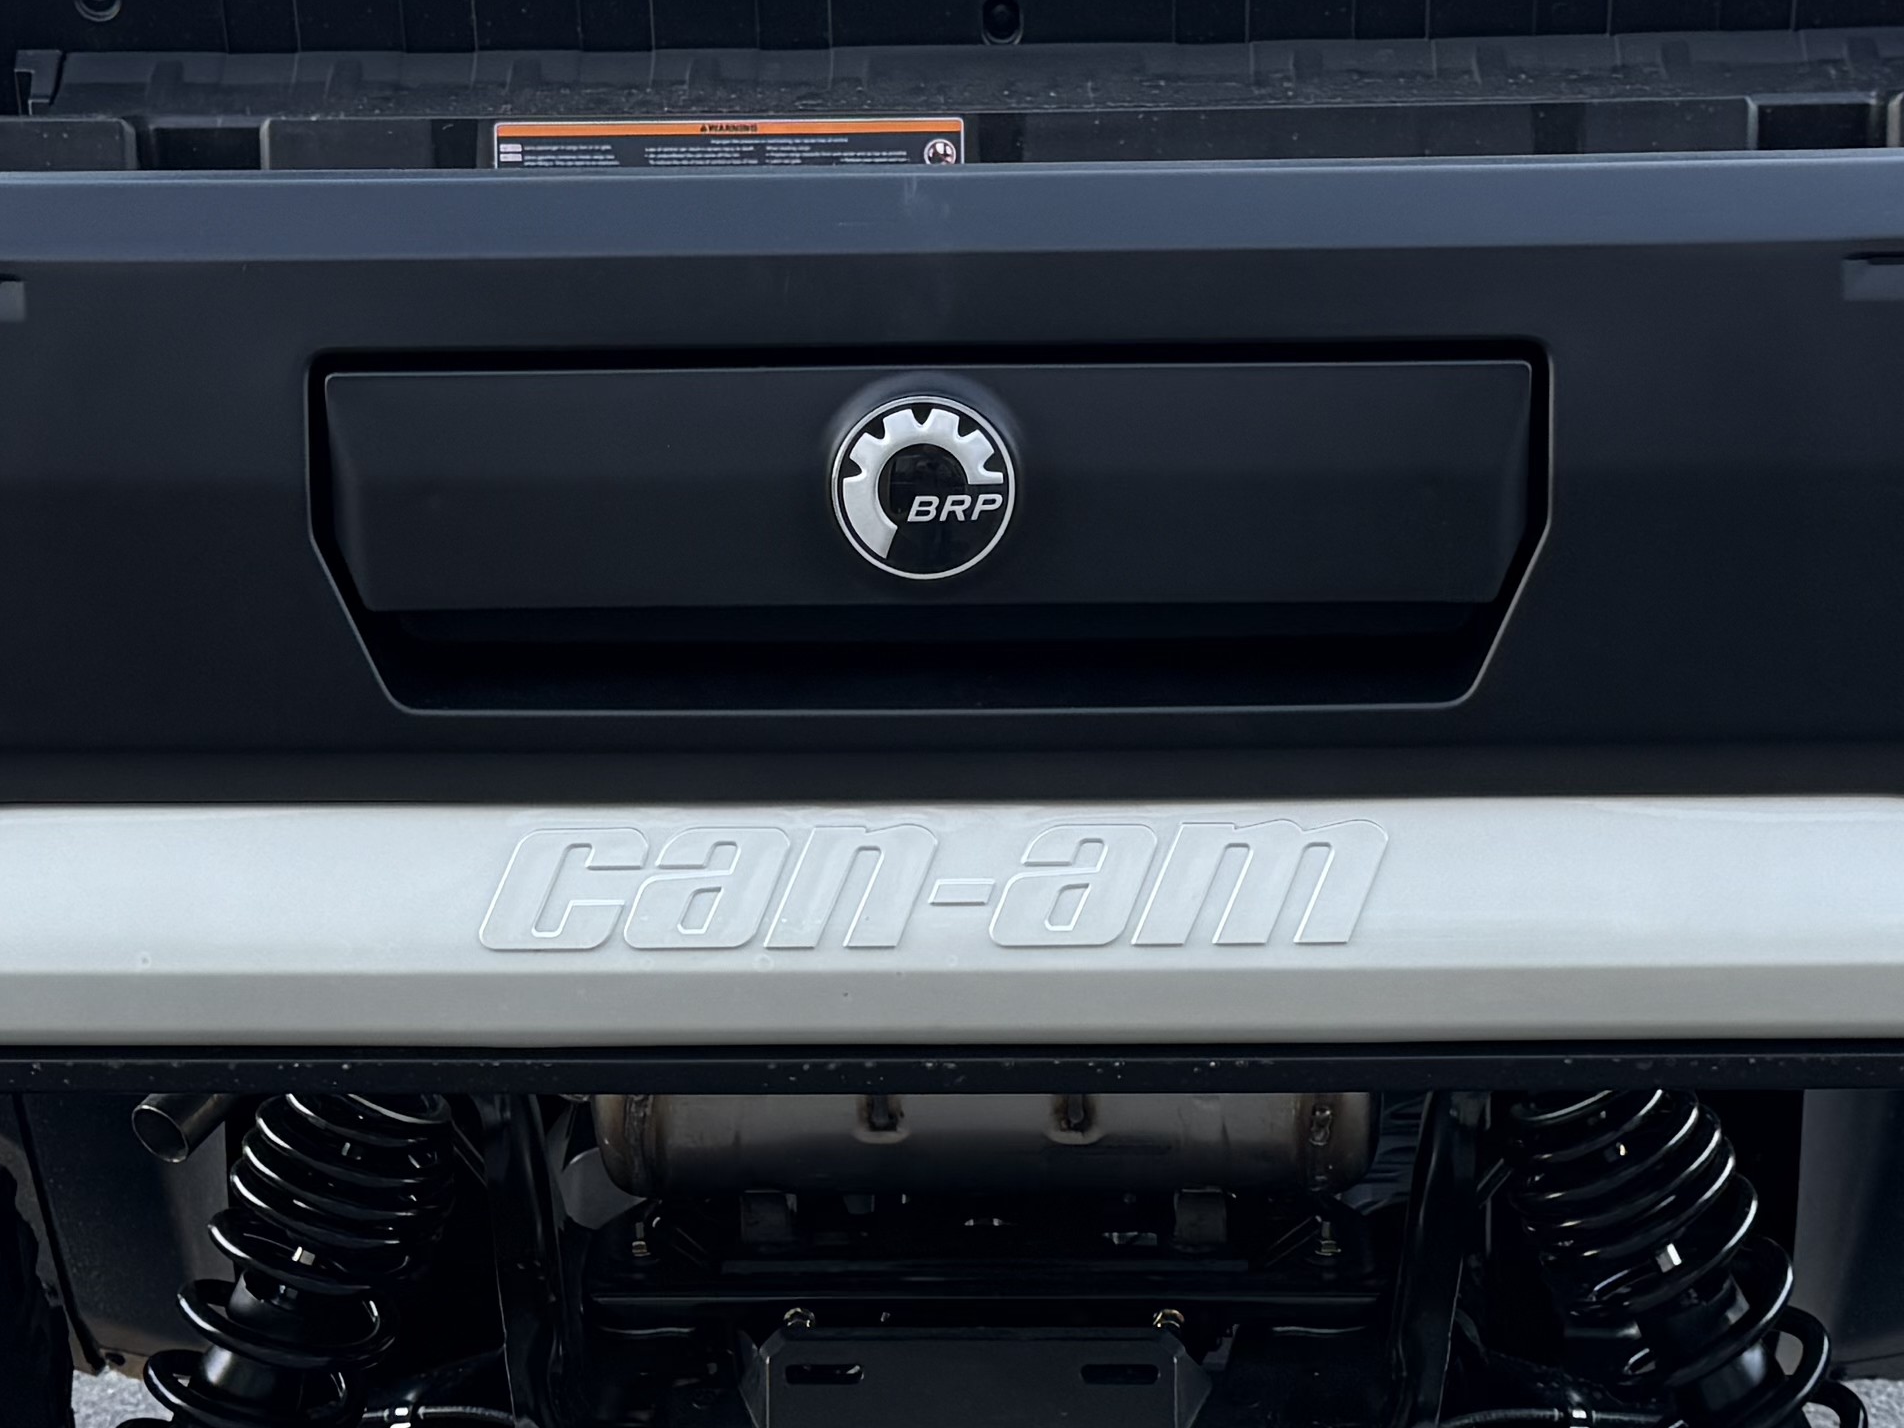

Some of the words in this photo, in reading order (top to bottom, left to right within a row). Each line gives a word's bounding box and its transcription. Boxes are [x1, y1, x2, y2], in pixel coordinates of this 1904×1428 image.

[708, 123, 758, 133] WARNING
[907, 493, 1004, 522] BRP
[478, 818, 1390, 951] can-am
